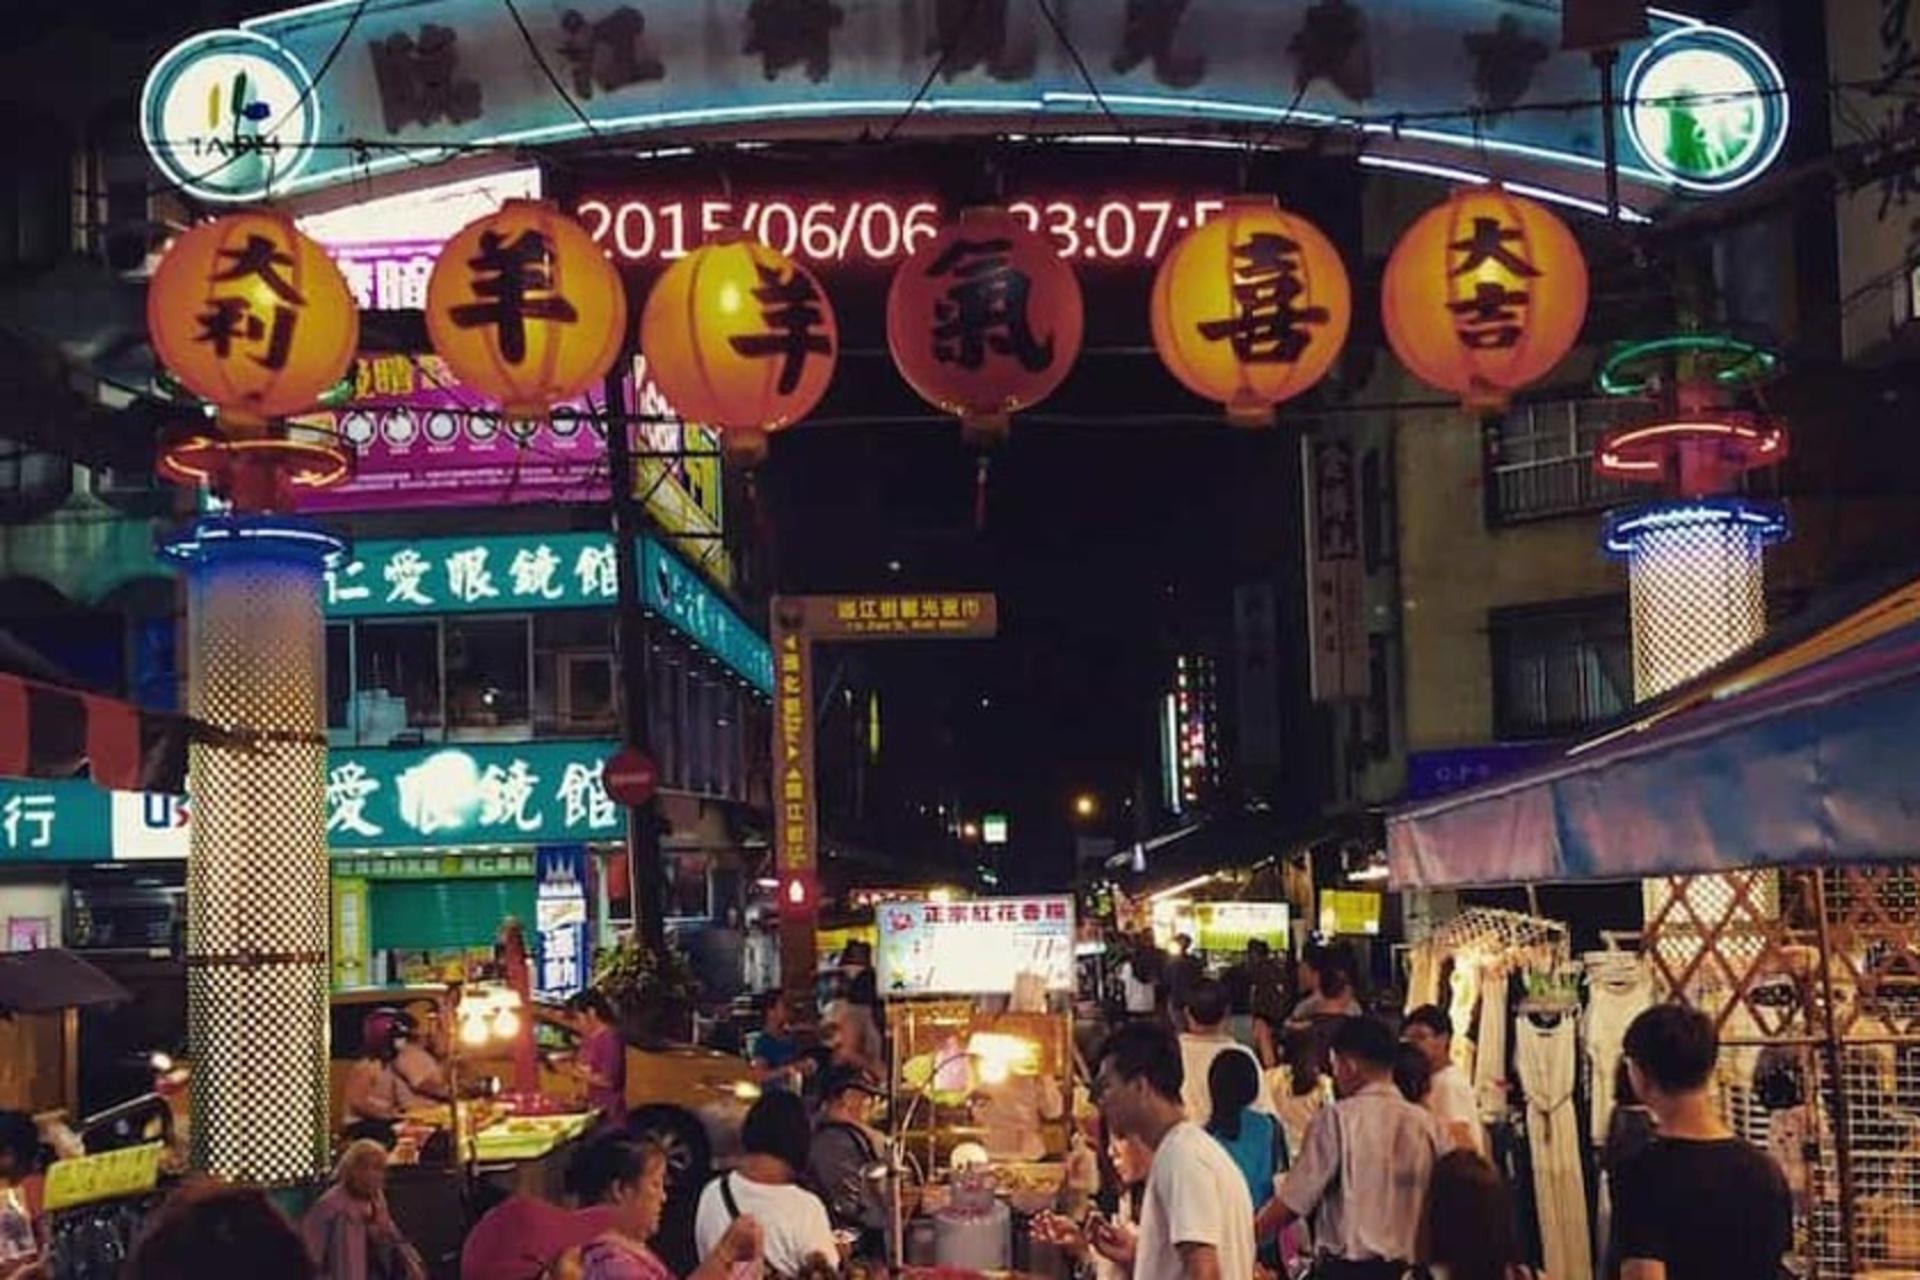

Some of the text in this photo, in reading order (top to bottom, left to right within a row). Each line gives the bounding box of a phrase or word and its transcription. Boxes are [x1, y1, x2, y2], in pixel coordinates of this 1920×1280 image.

[195, 232, 308, 370] 大利
[449, 228, 579, 367] 羊
[728, 261, 834, 396] 羊
[925, 237, 1055, 376] 氣
[1196, 232, 1331, 367] 喜
[1445, 216, 1544, 350] 大吉
[321, 543, 619, 605] 仁愛眼鏡館
[2, 793, 57, 849] 行
